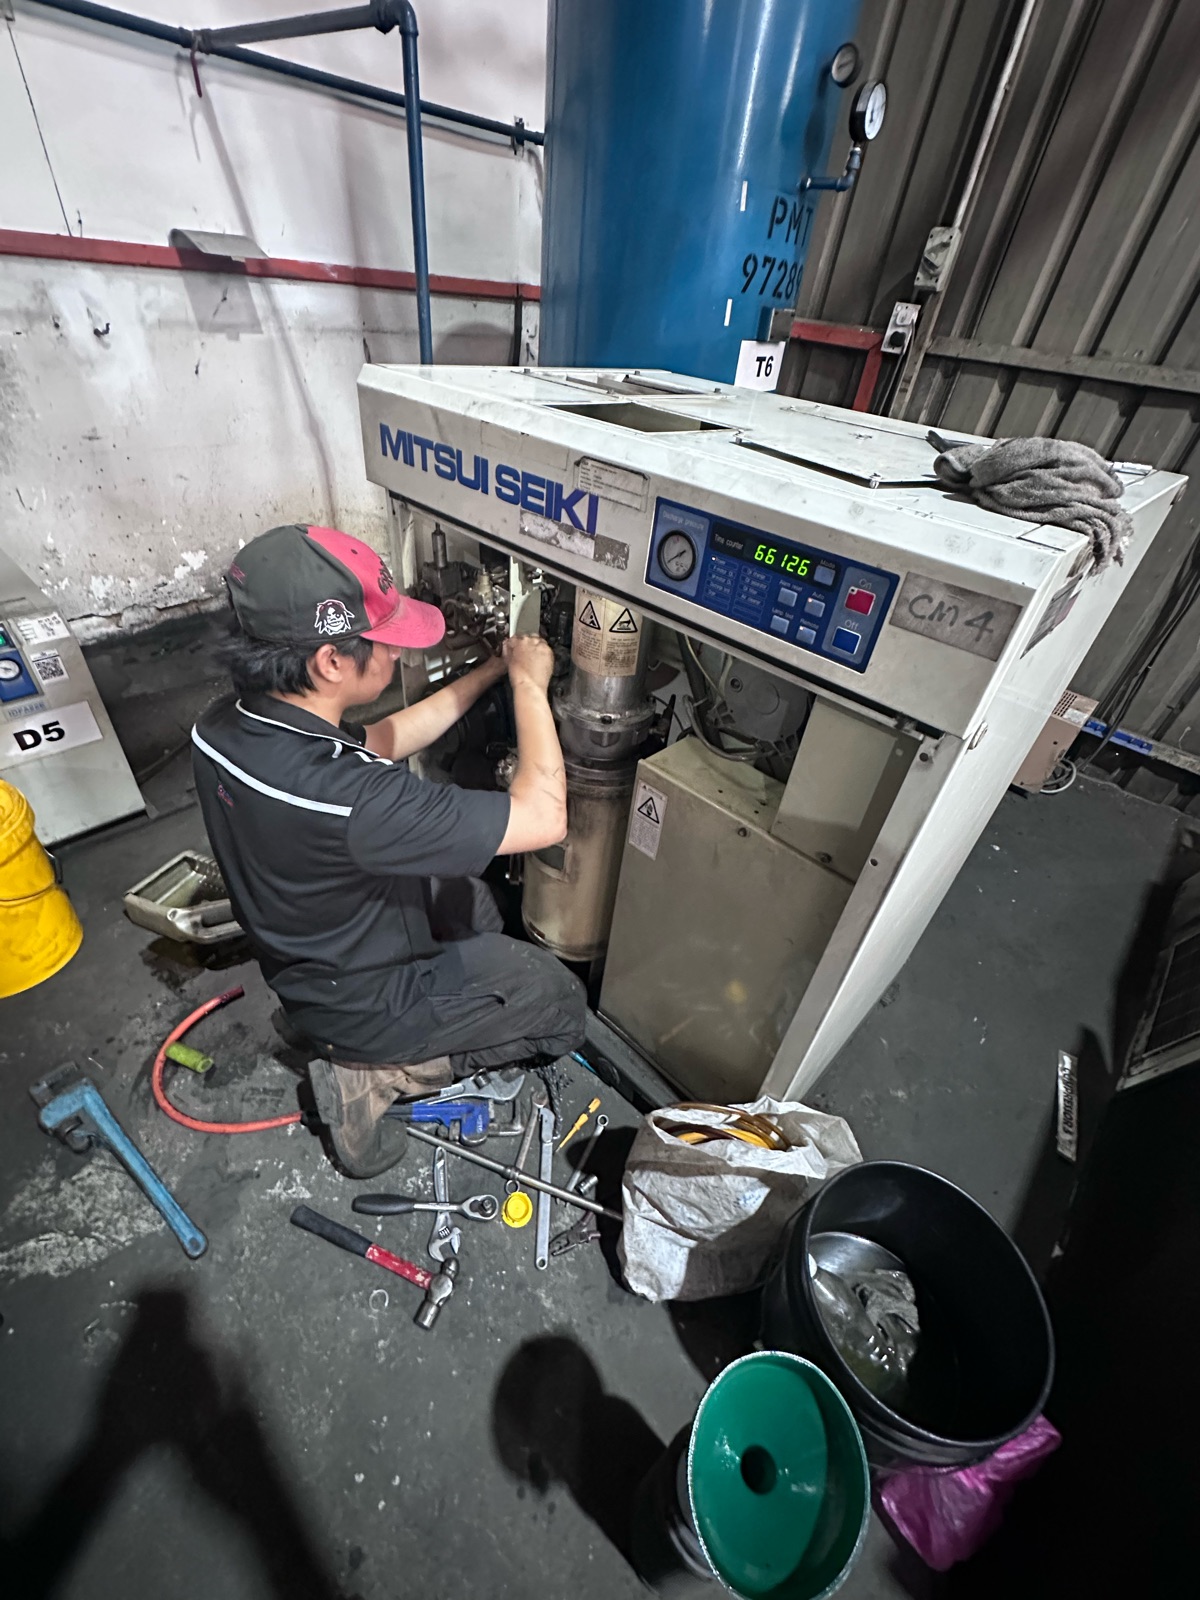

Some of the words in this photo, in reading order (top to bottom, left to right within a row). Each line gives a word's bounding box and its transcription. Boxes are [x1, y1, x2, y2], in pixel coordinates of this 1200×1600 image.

[767, 195, 814, 248] PMT
[756, 356, 773, 378] T6
[379, 422, 489, 495] MITSUI
[495, 462, 600, 536] SEIKI
[754, 544, 811, 577] 66126
[811, 591, 825, 600] Auto
[859, 578, 873, 590] On
[844, 619, 859, 631] Off
[13, 720, 65, 751] D5
